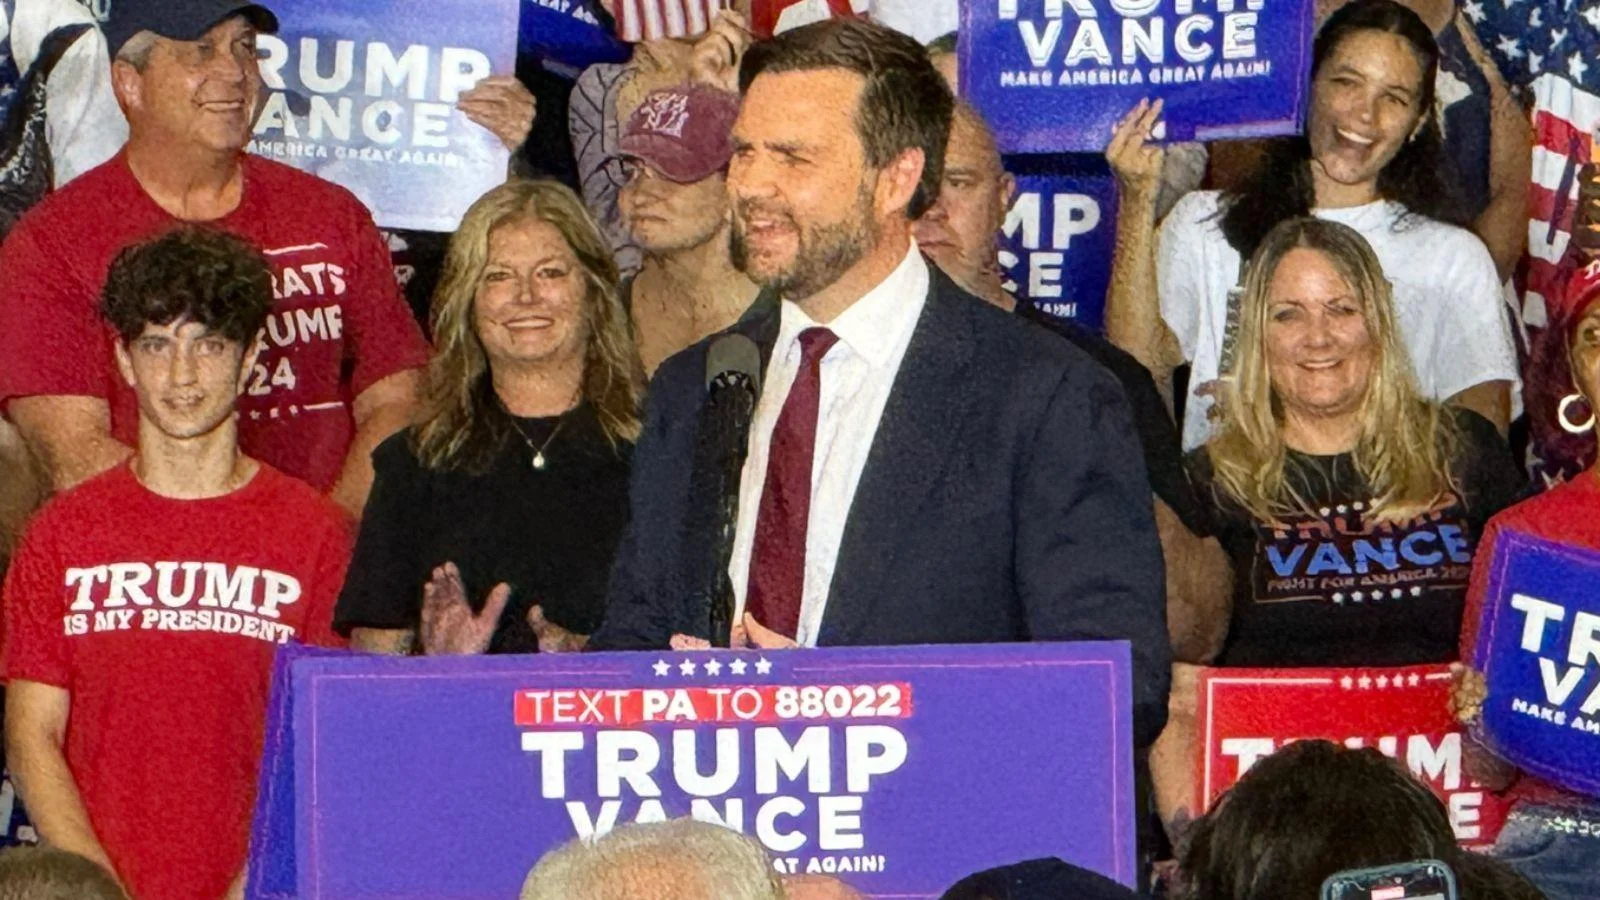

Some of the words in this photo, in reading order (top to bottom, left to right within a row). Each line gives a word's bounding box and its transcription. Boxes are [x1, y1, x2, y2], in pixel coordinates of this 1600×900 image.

[1018, 12, 1258, 67] VANCE
[256, 33, 491, 103] RUMP
[1000, 70, 1053, 87] MAKE
[1058, 69, 1143, 85] AMERICA
[1149, 65, 1204, 83] GREAT
[1211, 60, 1271, 79] AGAIN!
[252, 92, 450, 148] ANCE
[248, 357, 296, 395] 24
[1265, 524, 1471, 577] VANCE
[64, 561, 302, 618] TRUMP
[64, 613, 88, 635] IS
[94, 610, 135, 632] MY
[141, 609, 295, 644] PRESIDENT
[526, 690, 633, 723] TEXT
[642, 689, 698, 721] PA
[702, 688, 763, 720] TO
[774, 684, 902, 717] 88022
[1511, 698, 1567, 725] MAKE
[521, 725, 908, 798] TRUMP
[806, 855, 886, 874] AGAIN!
